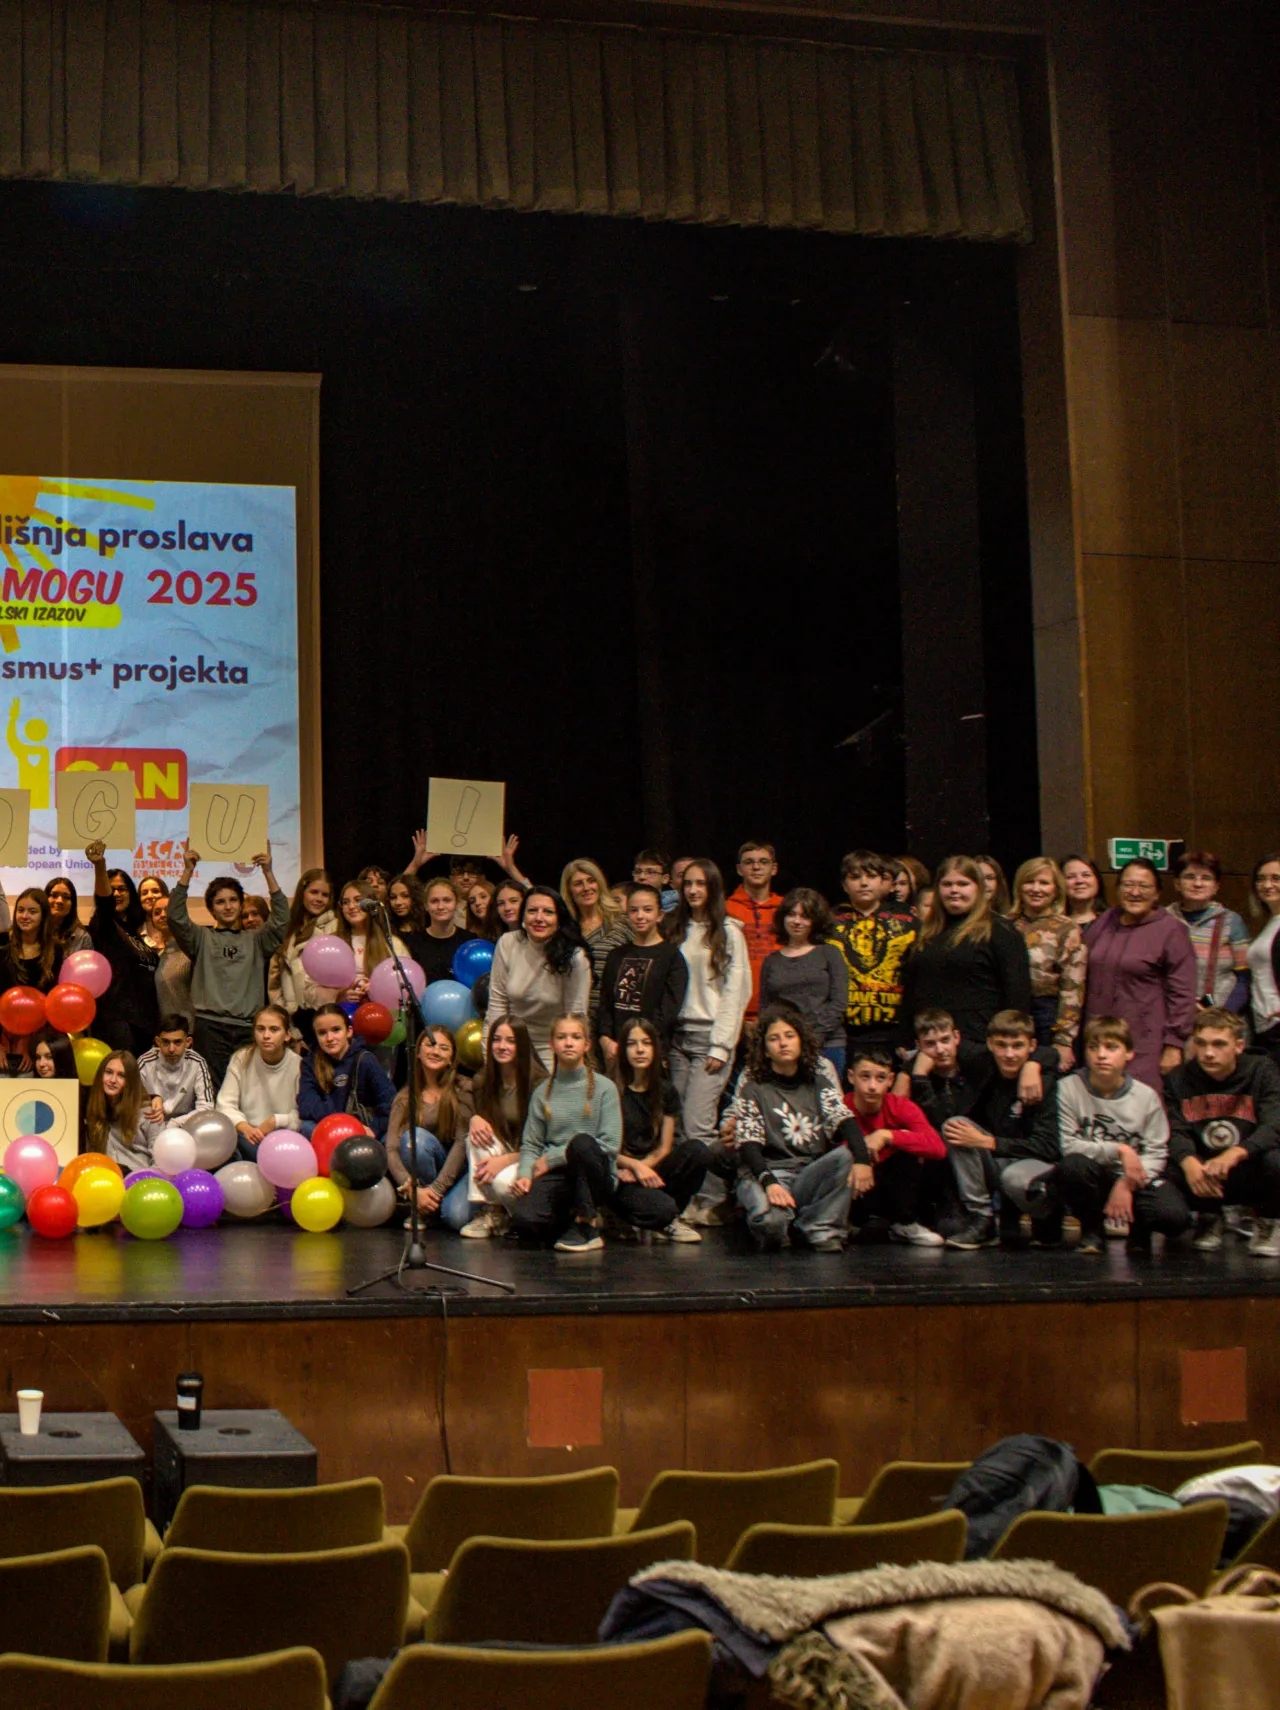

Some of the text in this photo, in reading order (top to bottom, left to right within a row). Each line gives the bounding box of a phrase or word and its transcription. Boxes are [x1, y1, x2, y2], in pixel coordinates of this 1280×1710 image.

[99, 519, 253, 557] proslava
[2, 568, 124, 605] MOGU
[146, 569, 258, 607] 2025
[32, 606, 86, 622] IZAZOV
[113, 655, 249, 691] projekta
[72, 779, 119, 841] G
[205, 793, 256, 854] U
[20, 859, 62, 870] opean
[49, 845, 62, 857] by
